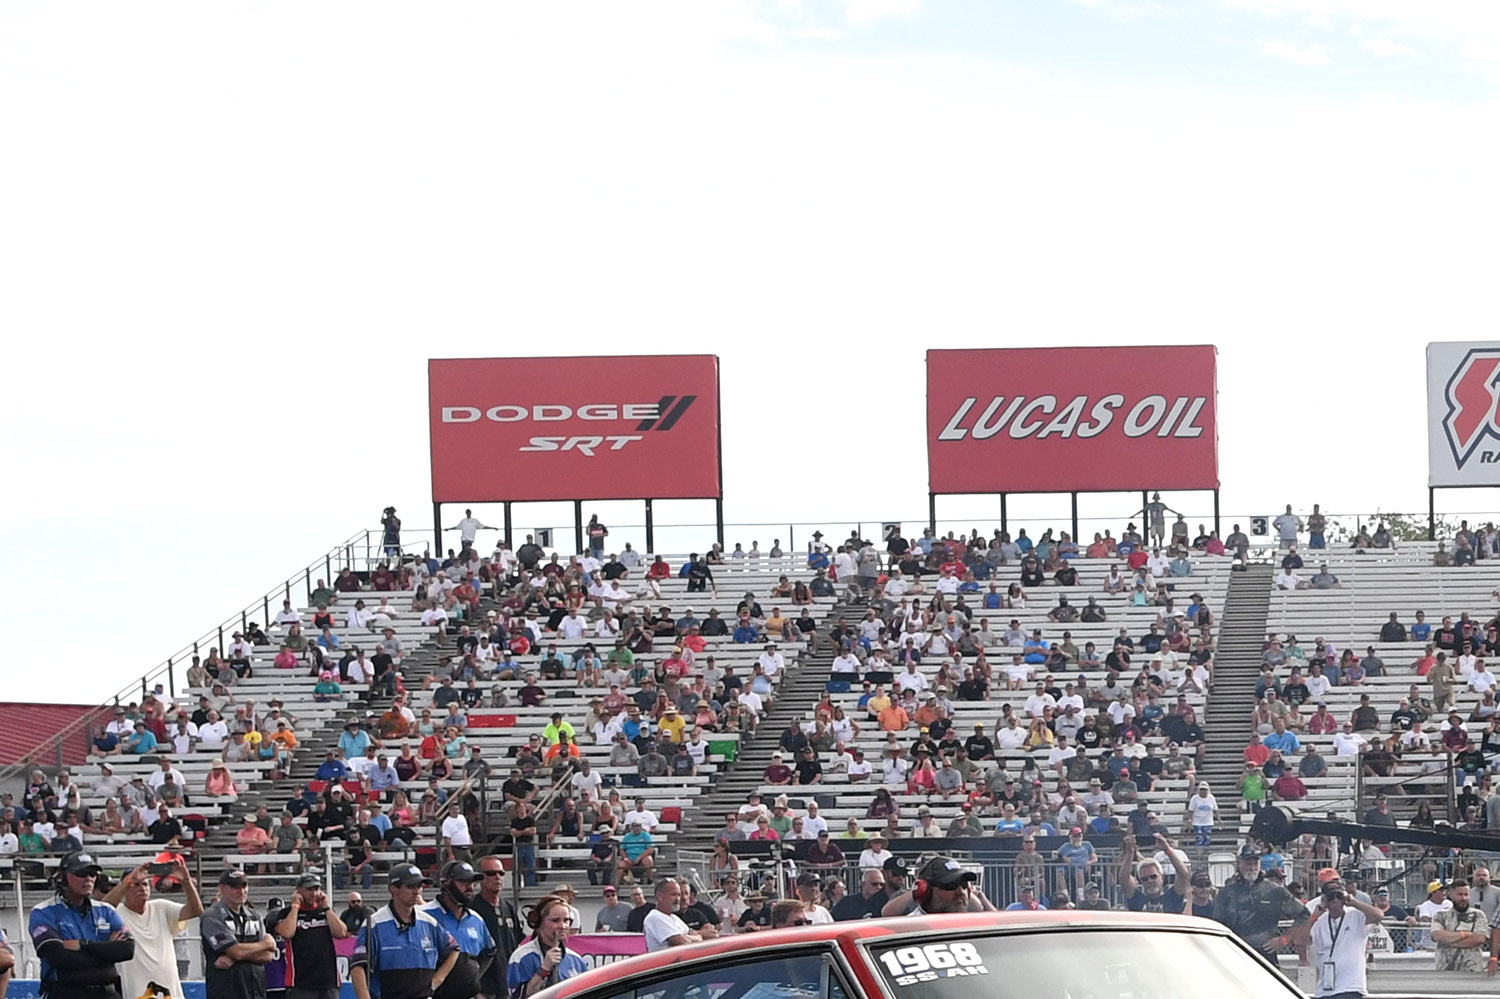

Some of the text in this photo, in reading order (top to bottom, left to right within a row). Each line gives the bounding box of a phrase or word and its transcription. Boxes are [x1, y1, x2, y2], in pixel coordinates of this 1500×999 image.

[442, 404, 660, 423] DODGE
[937, 394, 1208, 441] LUCAS OIL
[519, 435, 643, 456] SRT
[1252, 518, 1267, 536] 3
[879, 943, 983, 977] 1968
[896, 965, 989, 986] SS AH
